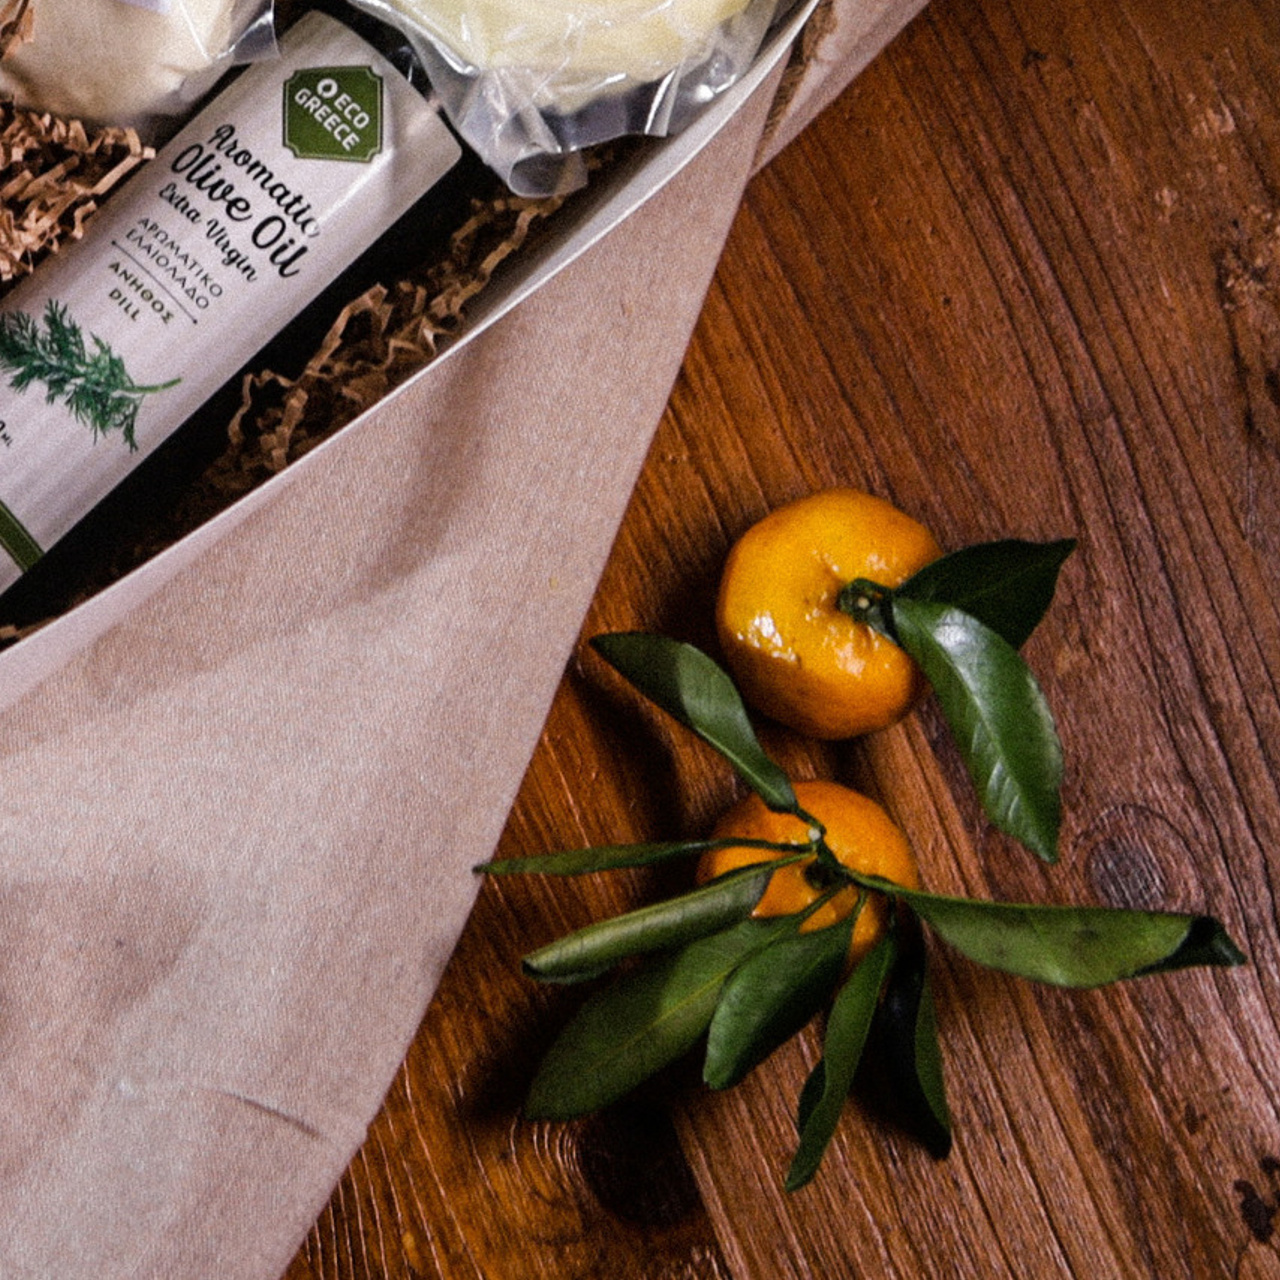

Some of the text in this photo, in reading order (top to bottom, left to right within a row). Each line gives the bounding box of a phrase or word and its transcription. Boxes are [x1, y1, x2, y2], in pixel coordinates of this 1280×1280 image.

[294, 88, 360, 152] GREECE
[333, 92, 370, 131] ECO
[159, 183, 257, 283] Extra Virgin
[171, 143, 308, 278] Olive Oil
[108, 287, 140, 322] DILL
